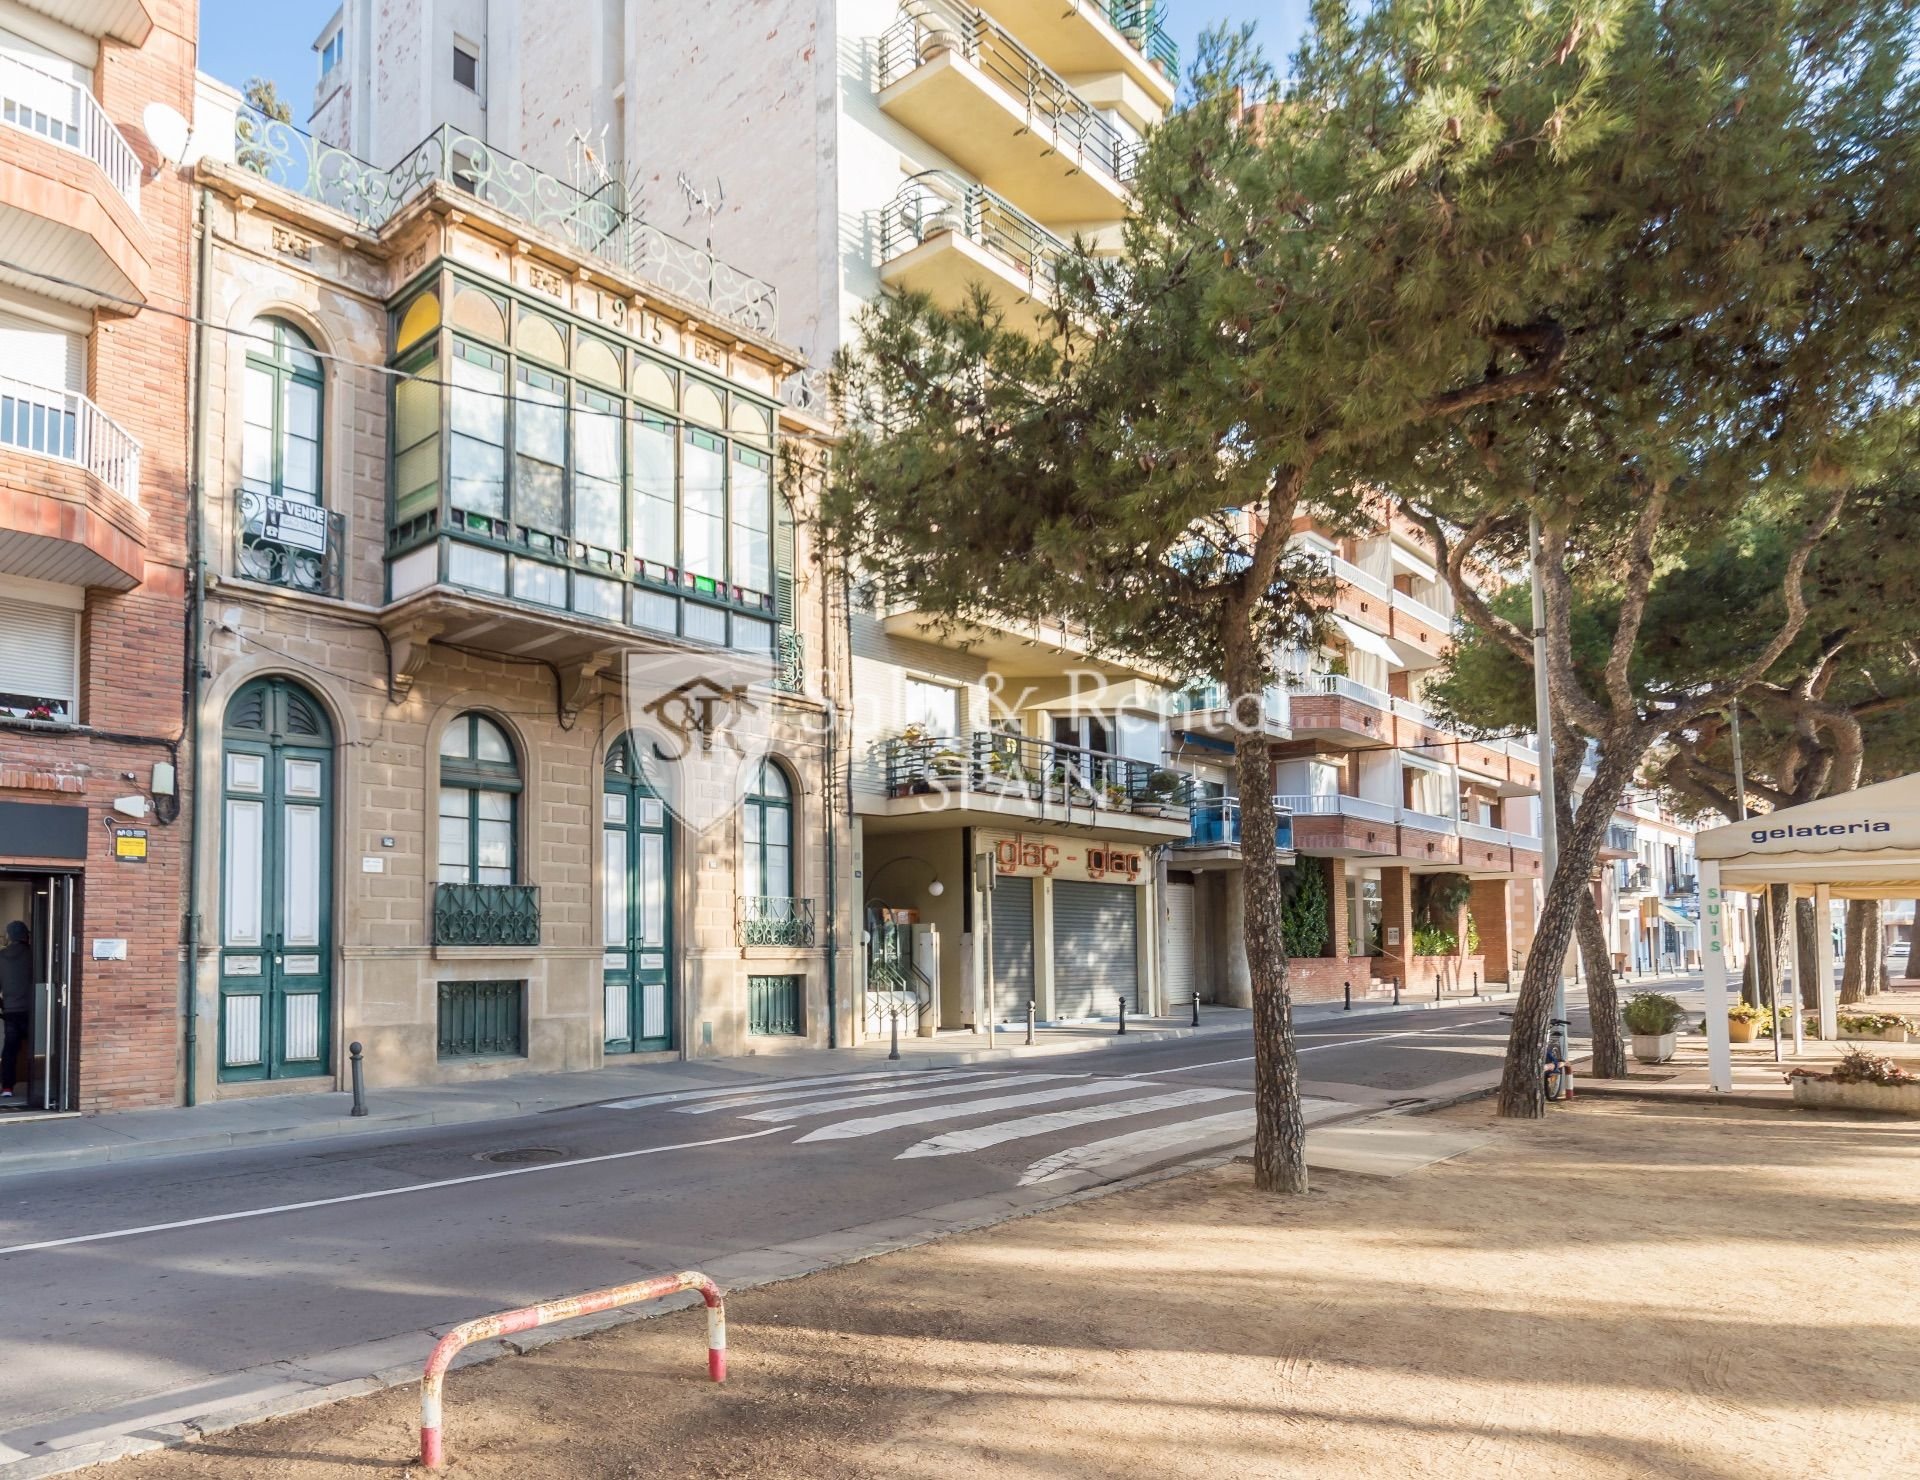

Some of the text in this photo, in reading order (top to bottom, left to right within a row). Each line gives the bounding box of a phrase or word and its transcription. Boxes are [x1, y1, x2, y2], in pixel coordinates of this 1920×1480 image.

[597, 290, 662, 344] 1915
[267, 497, 324, 524] SE VENDE
[1751, 819, 1890, 843] gelateria
[995, 832, 1059, 875] glaç
[1086, 841, 1141, 882] glaç
